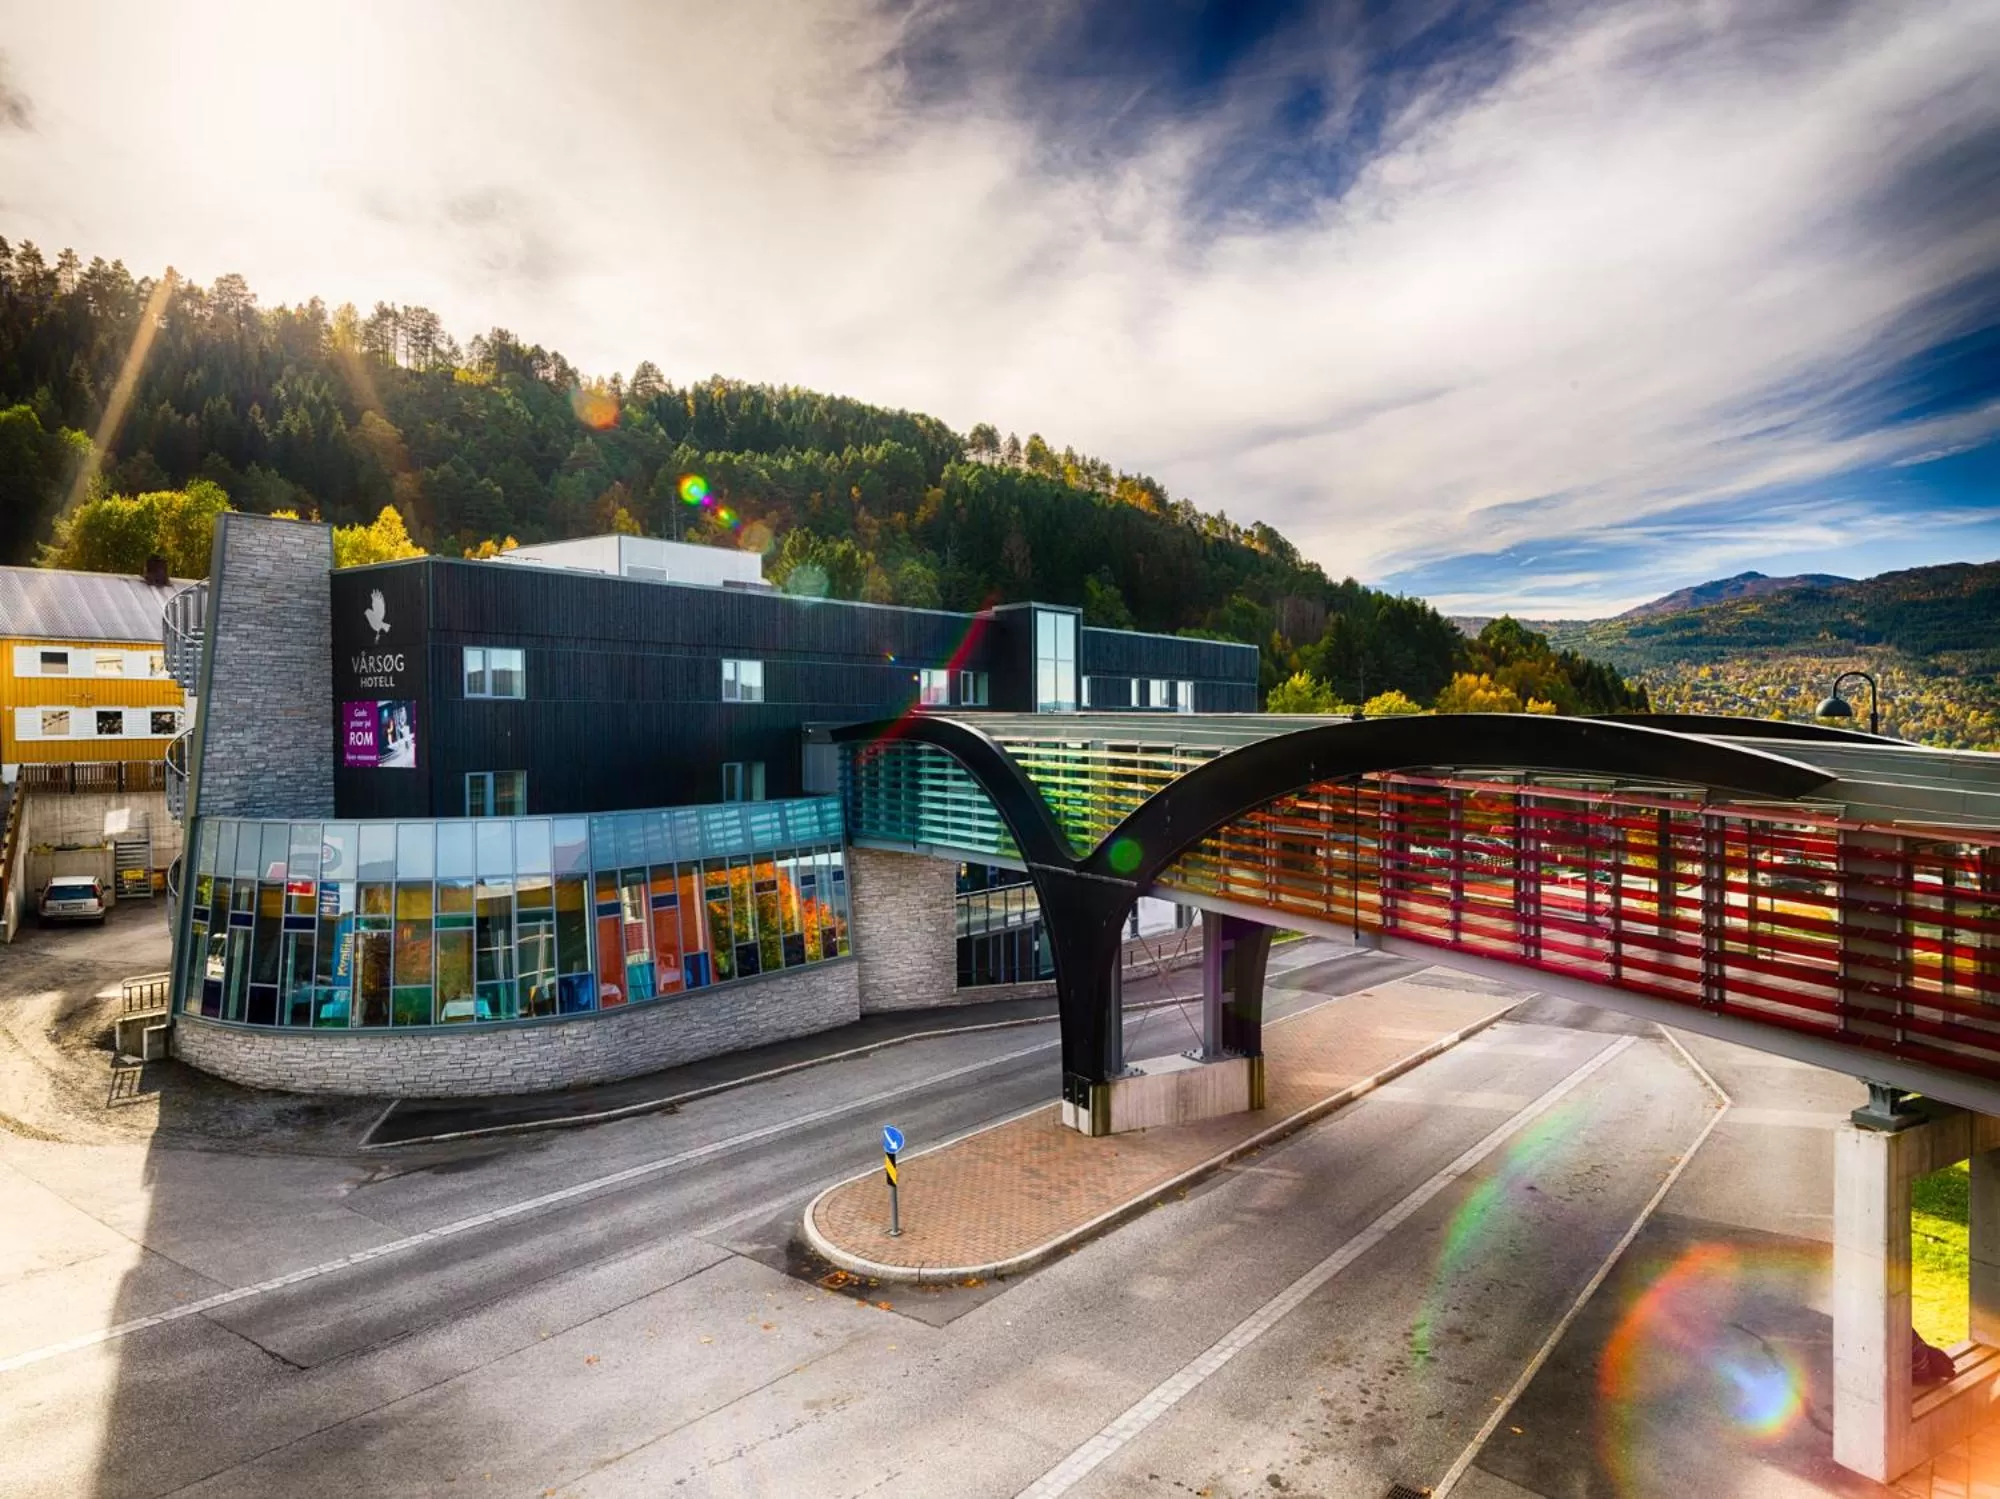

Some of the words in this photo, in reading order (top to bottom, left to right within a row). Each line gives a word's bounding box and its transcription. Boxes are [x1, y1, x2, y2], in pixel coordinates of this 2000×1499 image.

[351, 650, 405, 673] VÅRSØG
[360, 675, 396, 689] HOTELL
[349, 731, 373, 746] ROM
